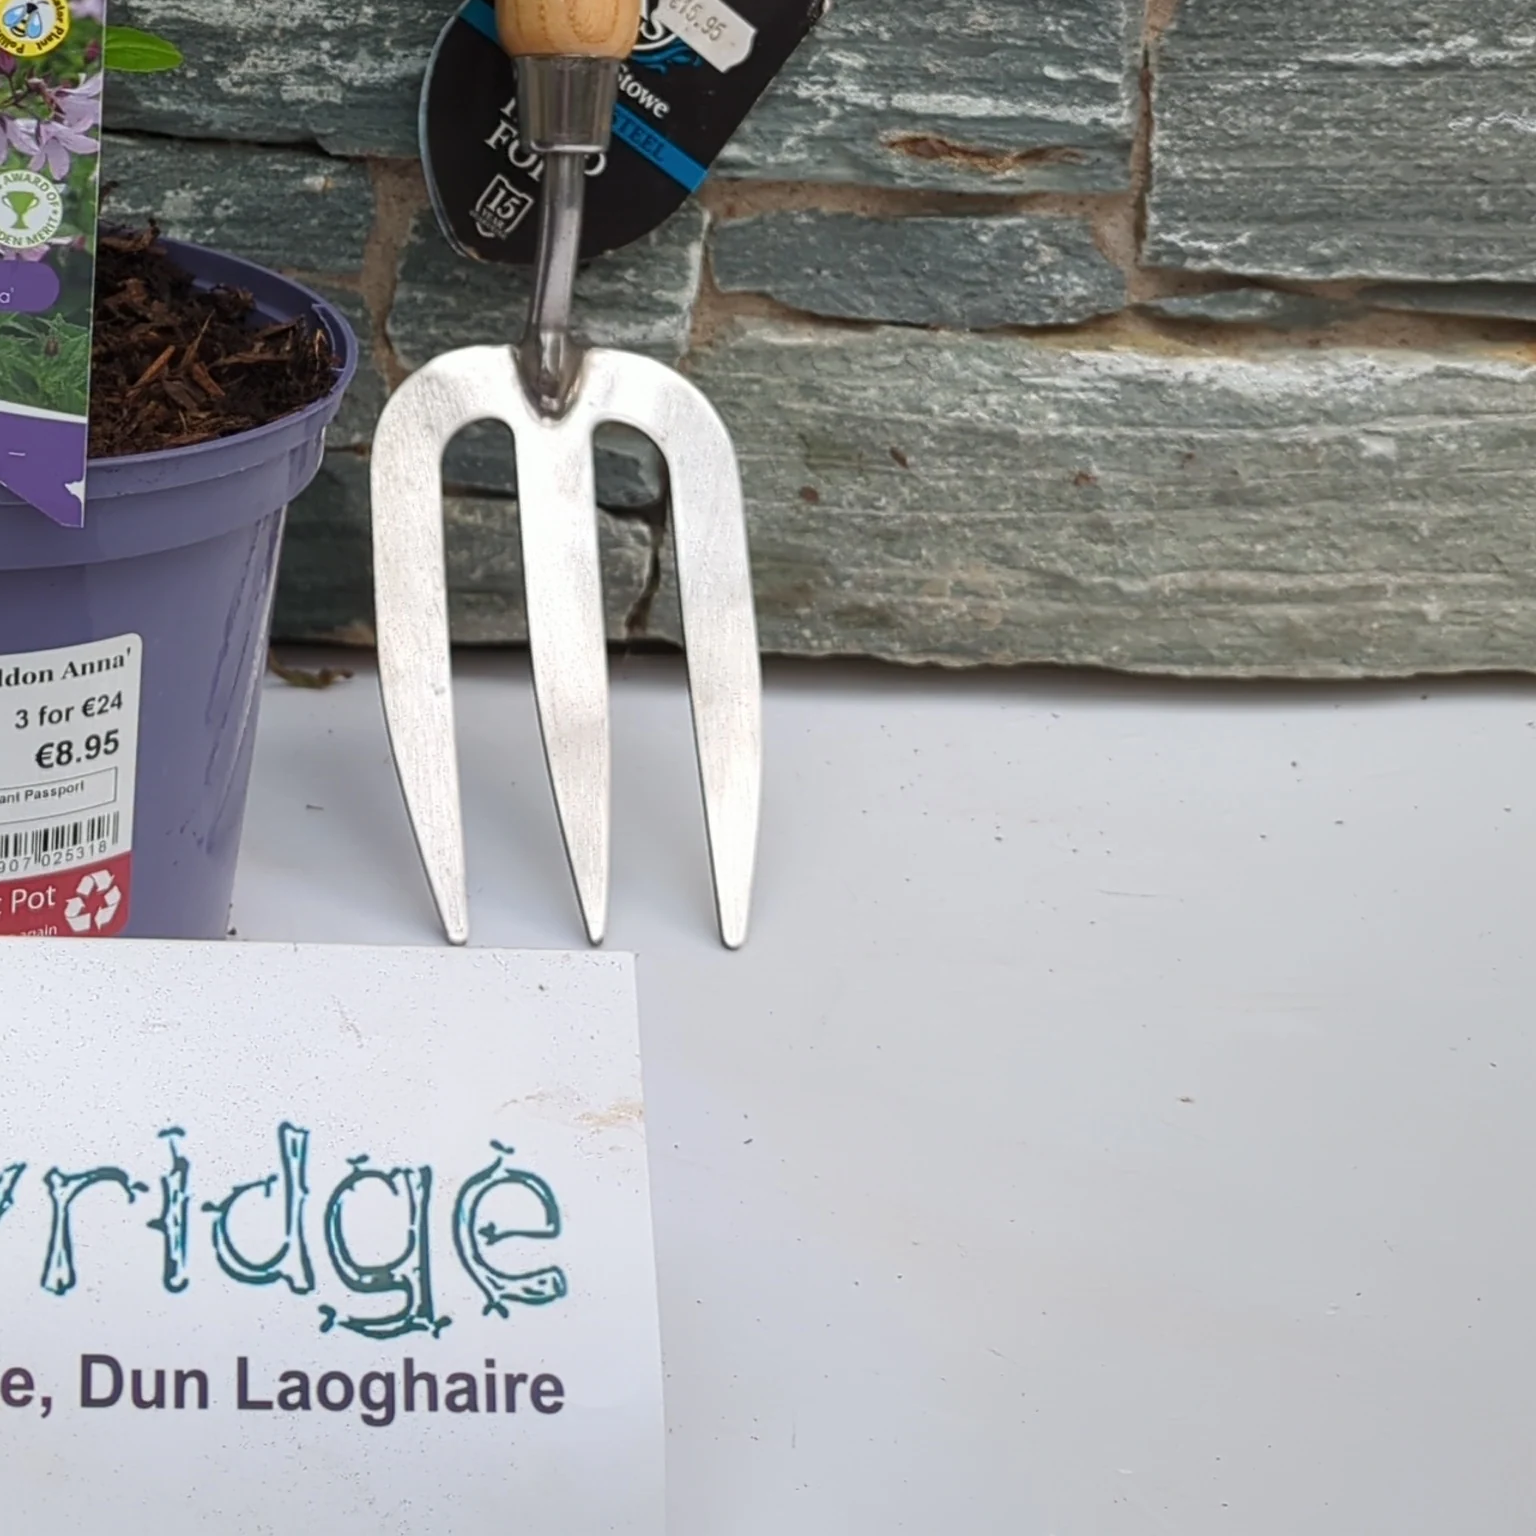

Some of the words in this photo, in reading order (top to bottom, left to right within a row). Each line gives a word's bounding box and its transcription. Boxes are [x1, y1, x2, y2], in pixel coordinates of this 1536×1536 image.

[35, 24, 65, 51] Plant
[3, 172, 50, 193] AWARD
[46, 192, 60, 208] OF
[486, 186, 521, 220] 15
[26, 214, 59, 245] MERIT
[60, 647, 132, 681] Anna'
[14, 708, 29, 730] 3
[38, 704, 75, 727] for
[81, 690, 124, 718] €24
[34, 728, 121, 770] €8.95
[24, 779, 86, 802] Passport
[40, 840, 108, 868] 025318
[11, 885, 57, 914] Pot
[80, 1354, 210, 1410] Dun
[237, 1357, 566, 1428] Laoghaire
